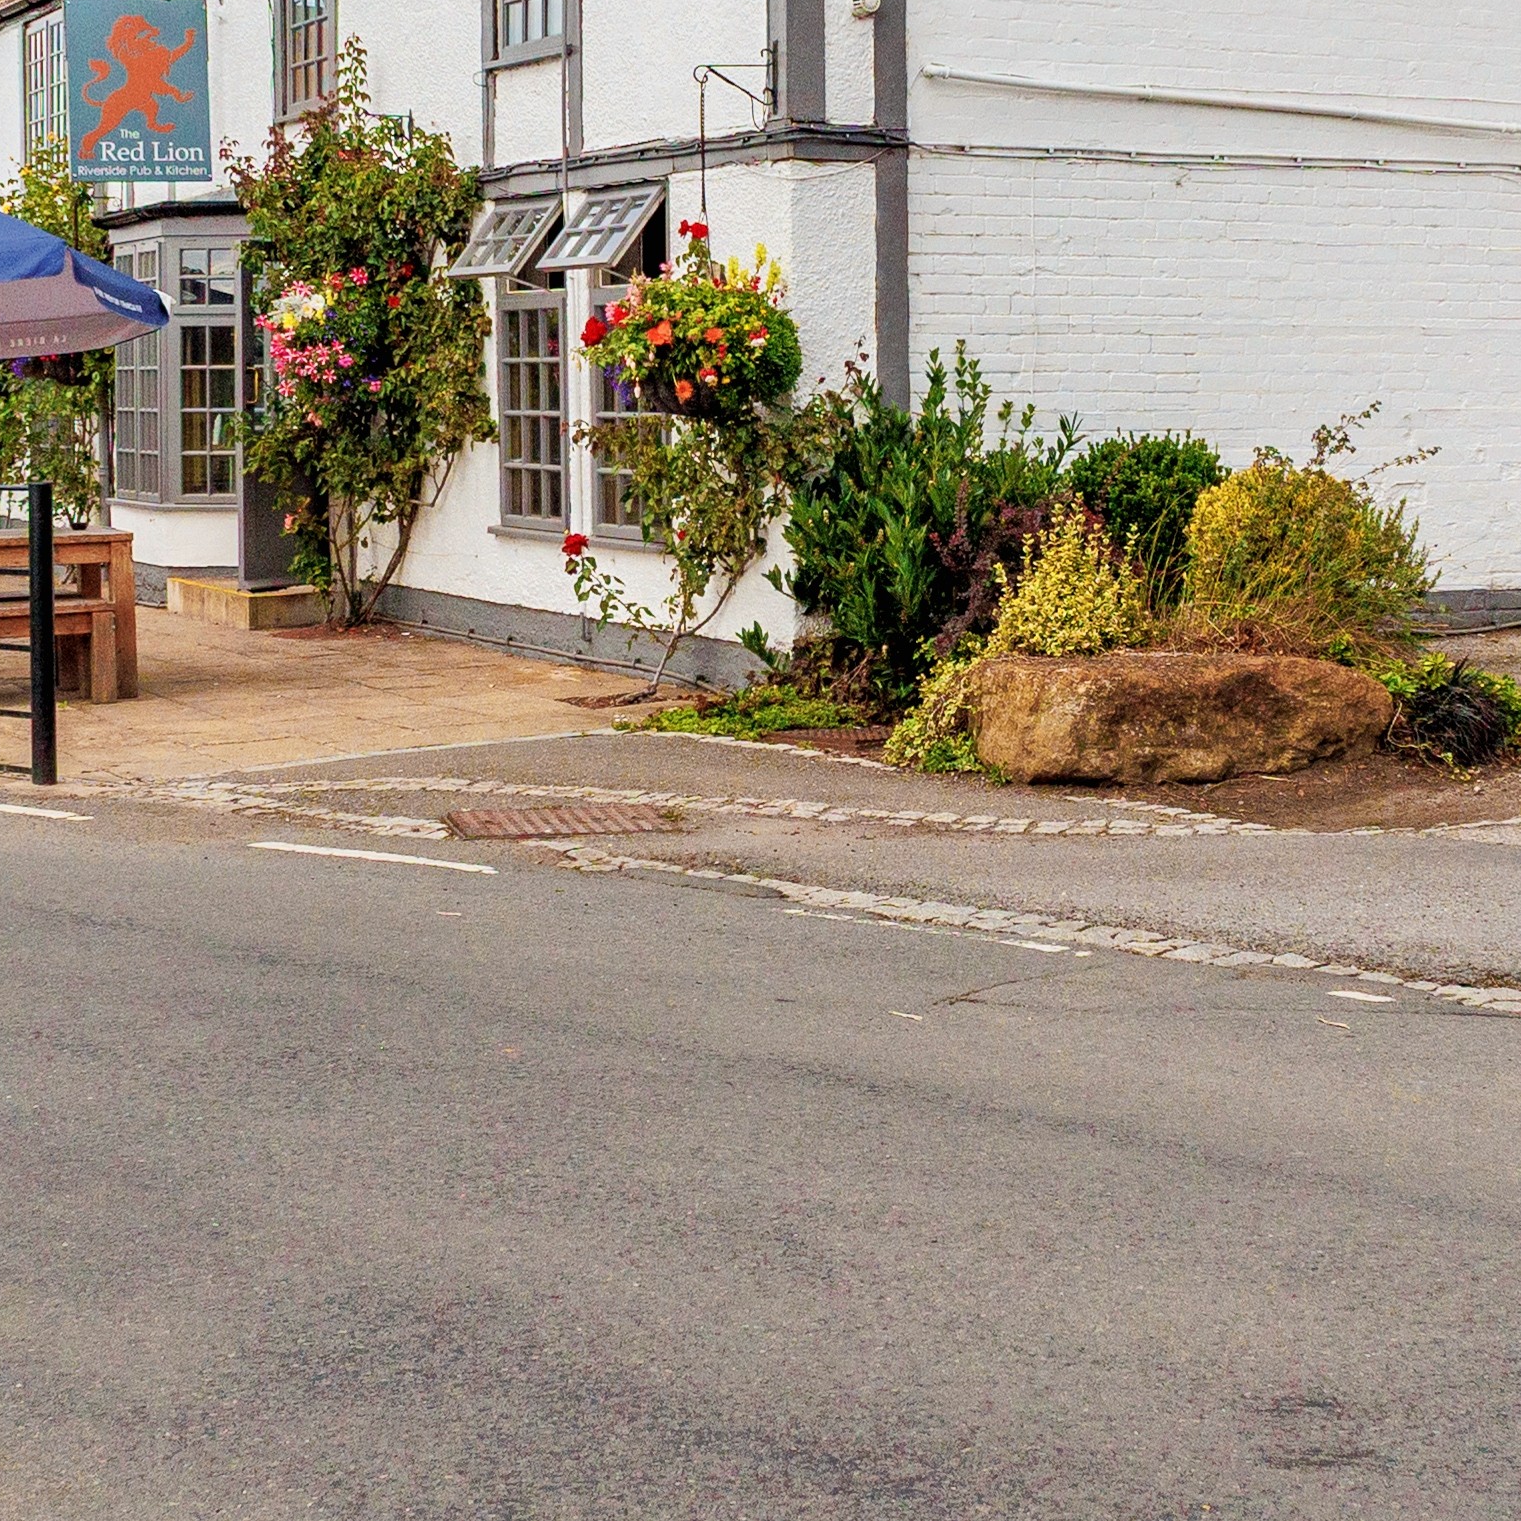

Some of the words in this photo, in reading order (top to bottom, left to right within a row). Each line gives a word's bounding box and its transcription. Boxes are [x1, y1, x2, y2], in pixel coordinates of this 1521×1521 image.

[120, 128, 140, 139] The
[99, 141, 146, 162] Red
[151, 141, 205, 162] Lion
[77, 165, 127, 176] Riverside
[129, 165, 152, 176] Pub
[154, 165, 164, 176] &
[165, 165, 208, 176] Kitchen
